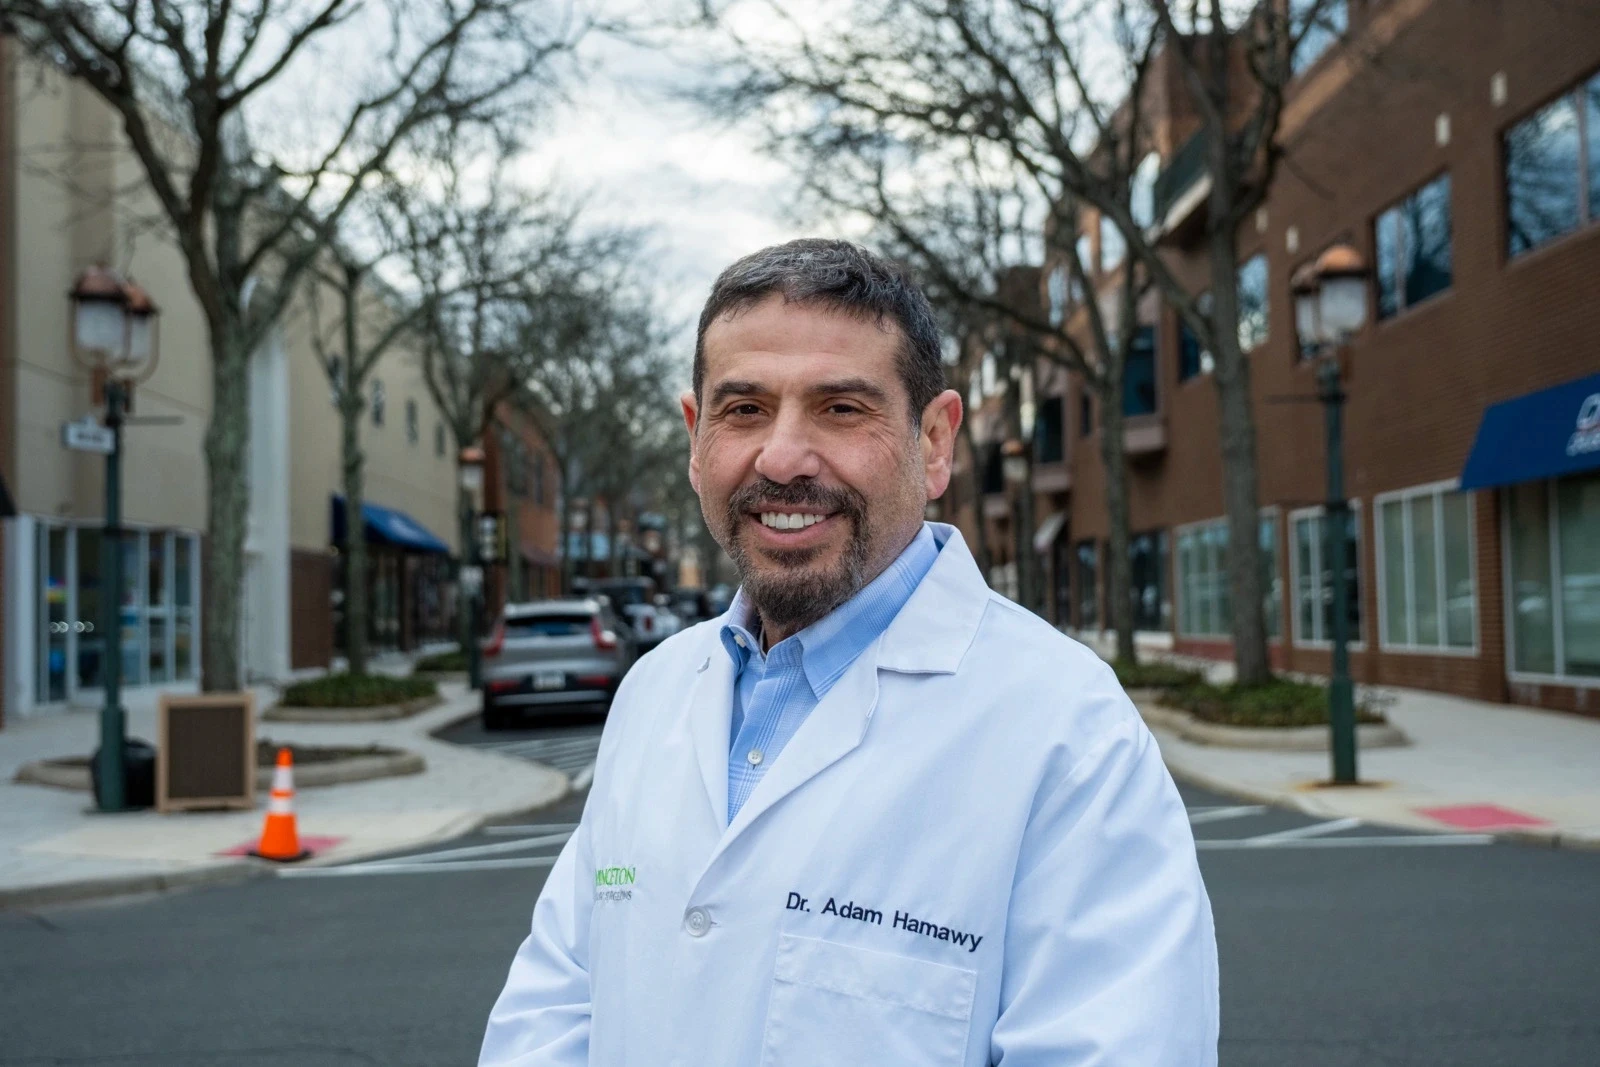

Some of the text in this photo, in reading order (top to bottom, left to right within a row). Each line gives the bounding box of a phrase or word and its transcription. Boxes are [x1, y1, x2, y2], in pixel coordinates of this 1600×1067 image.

[786, 891, 983, 953] Dr. Adam Hamawy
